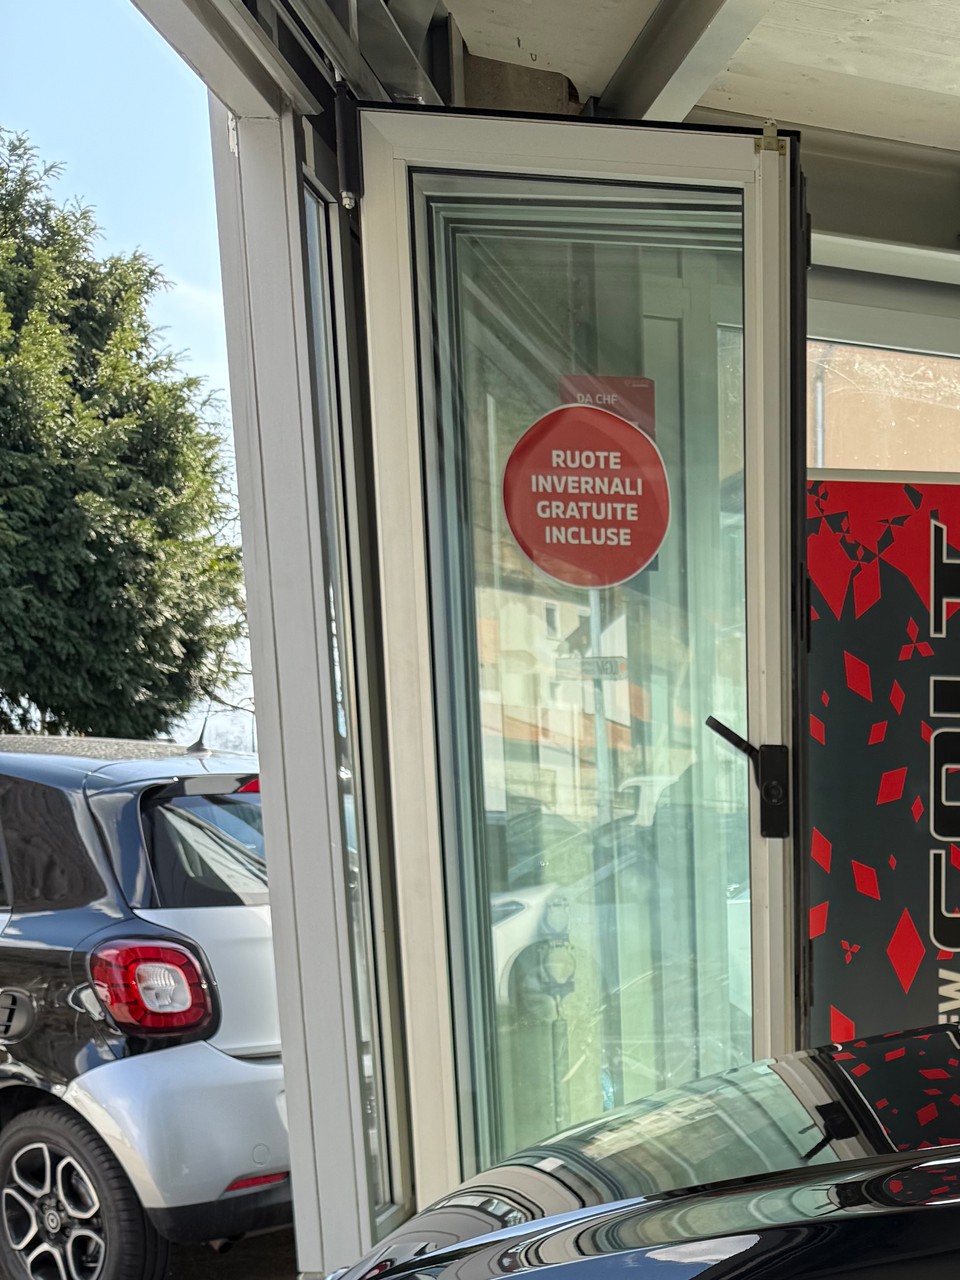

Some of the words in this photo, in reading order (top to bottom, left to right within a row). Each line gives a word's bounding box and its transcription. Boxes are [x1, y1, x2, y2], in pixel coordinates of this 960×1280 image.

[576, 393, 593, 404] DA
[595, 393, 618, 405] CHF
[551, 450, 621, 469] RUOTE
[531, 474, 643, 496] INVERNALI
[536, 500, 639, 521] GRATUITE
[545, 526, 632, 546] INCLUSE
